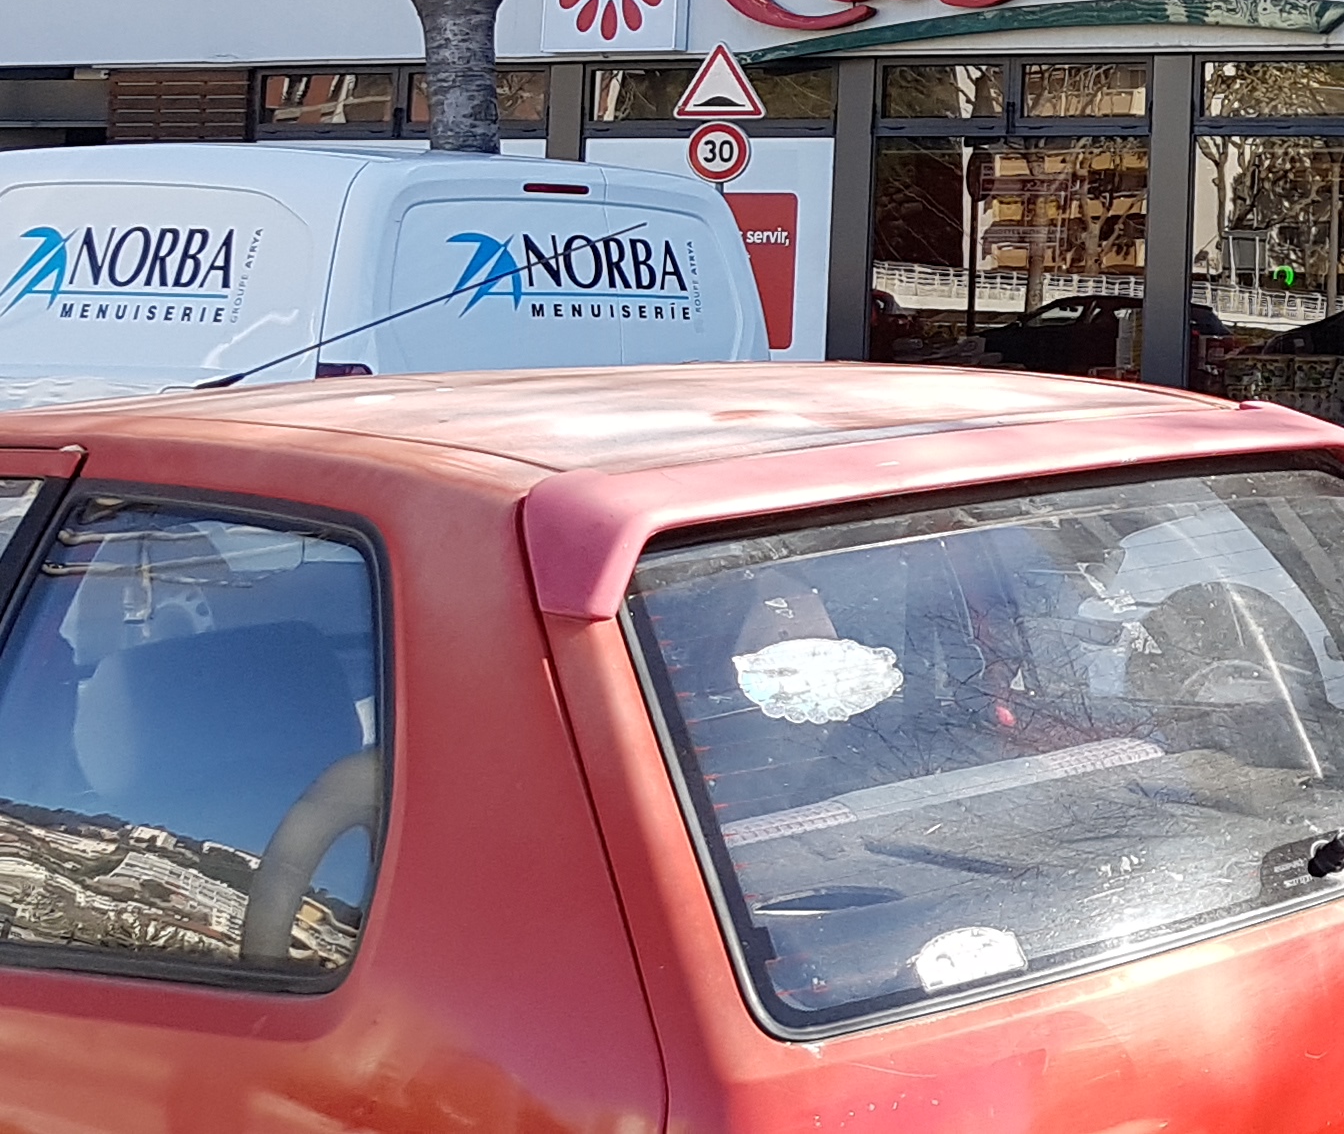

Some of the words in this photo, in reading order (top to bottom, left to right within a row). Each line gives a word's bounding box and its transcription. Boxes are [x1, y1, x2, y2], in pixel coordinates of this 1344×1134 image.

[703, 140, 736, 165] 30
[246, 227, 264, 269] ATRYA
[745, 227, 790, 247] servir,
[68, 226, 235, 289] NORBA
[522, 233, 688, 292] NORBA
[686, 240, 698, 275] ATRYA
[59, 302, 226, 323] MENUISERIE
[531, 303, 692, 321] MENUISERIE
